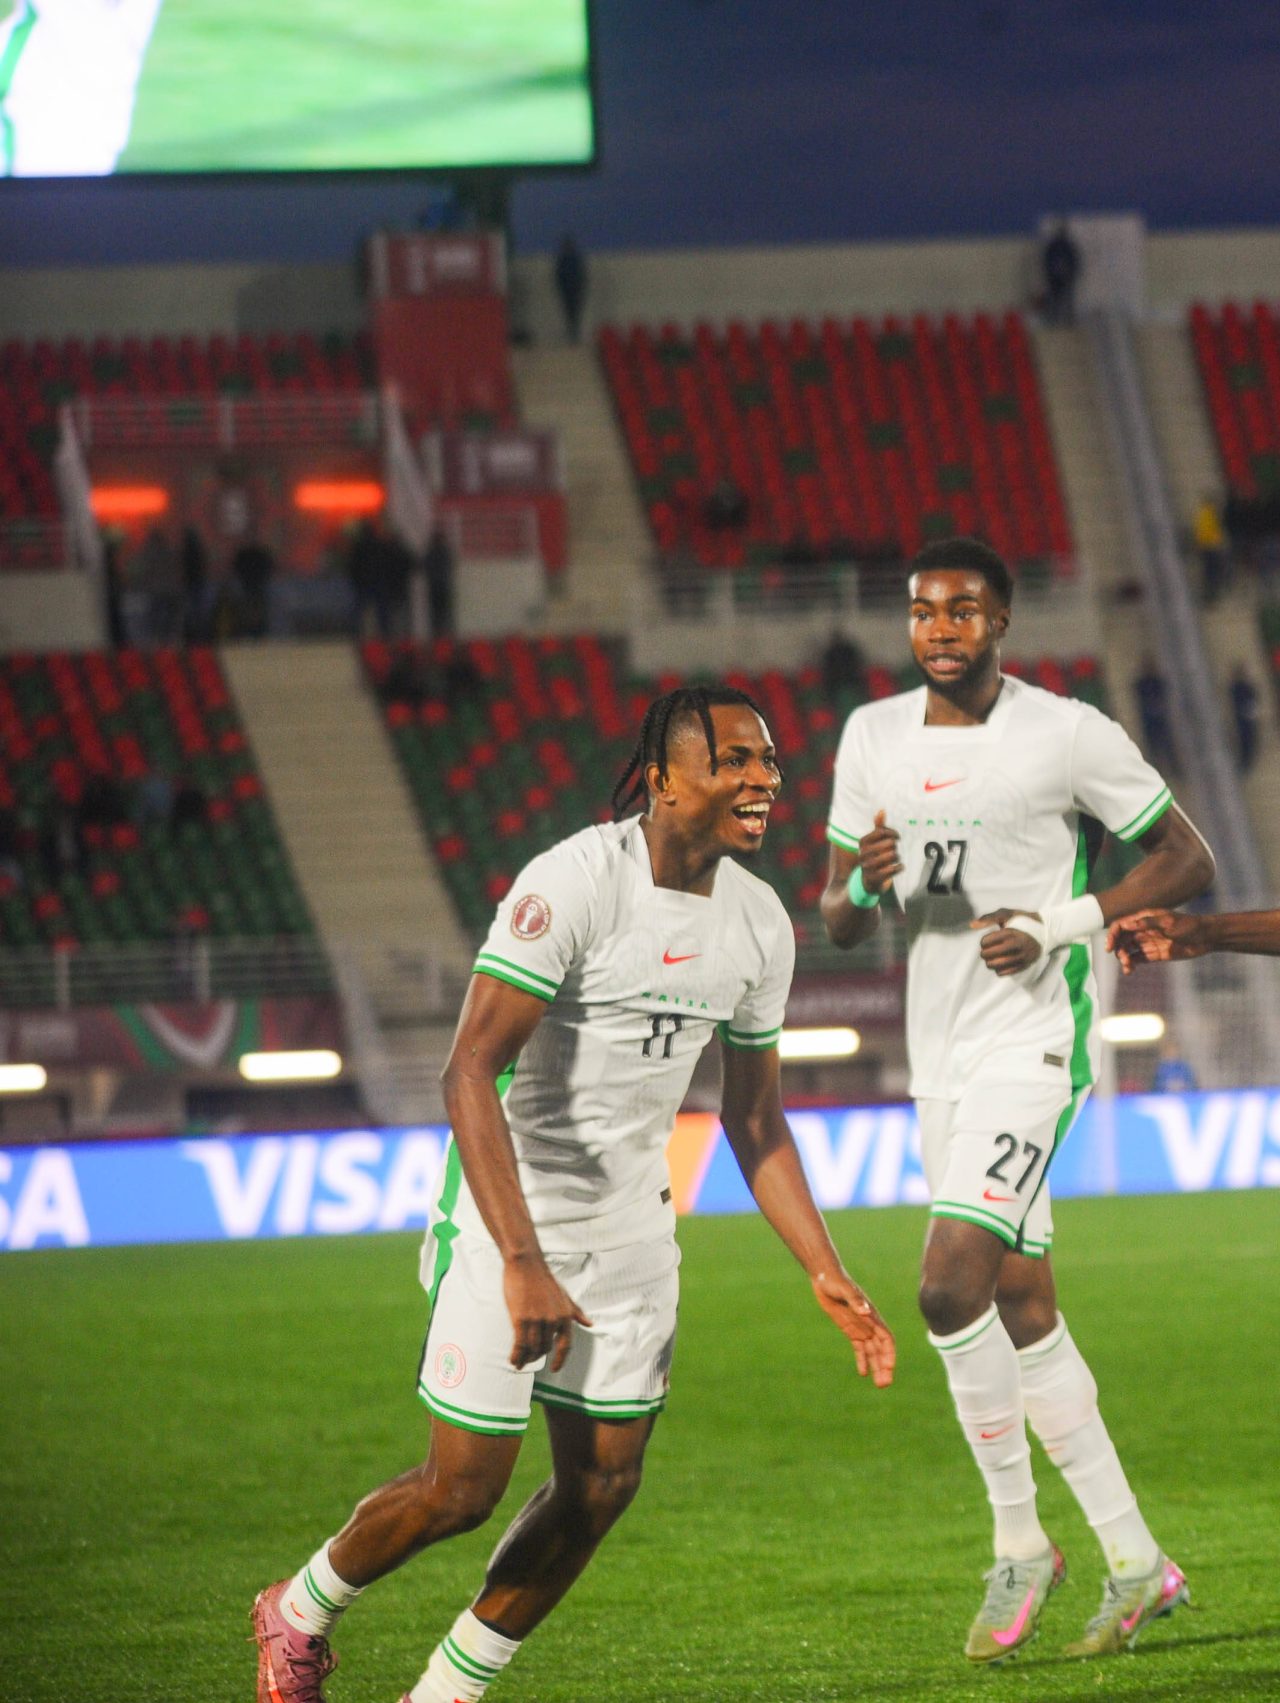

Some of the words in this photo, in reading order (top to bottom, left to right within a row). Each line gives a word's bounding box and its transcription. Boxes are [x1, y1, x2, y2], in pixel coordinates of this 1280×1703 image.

[924, 840, 968, 894] 27
[642, 1013, 685, 1060] 11
[184, 1130, 443, 1239] VISA
[986, 1133, 1043, 1194] 27
